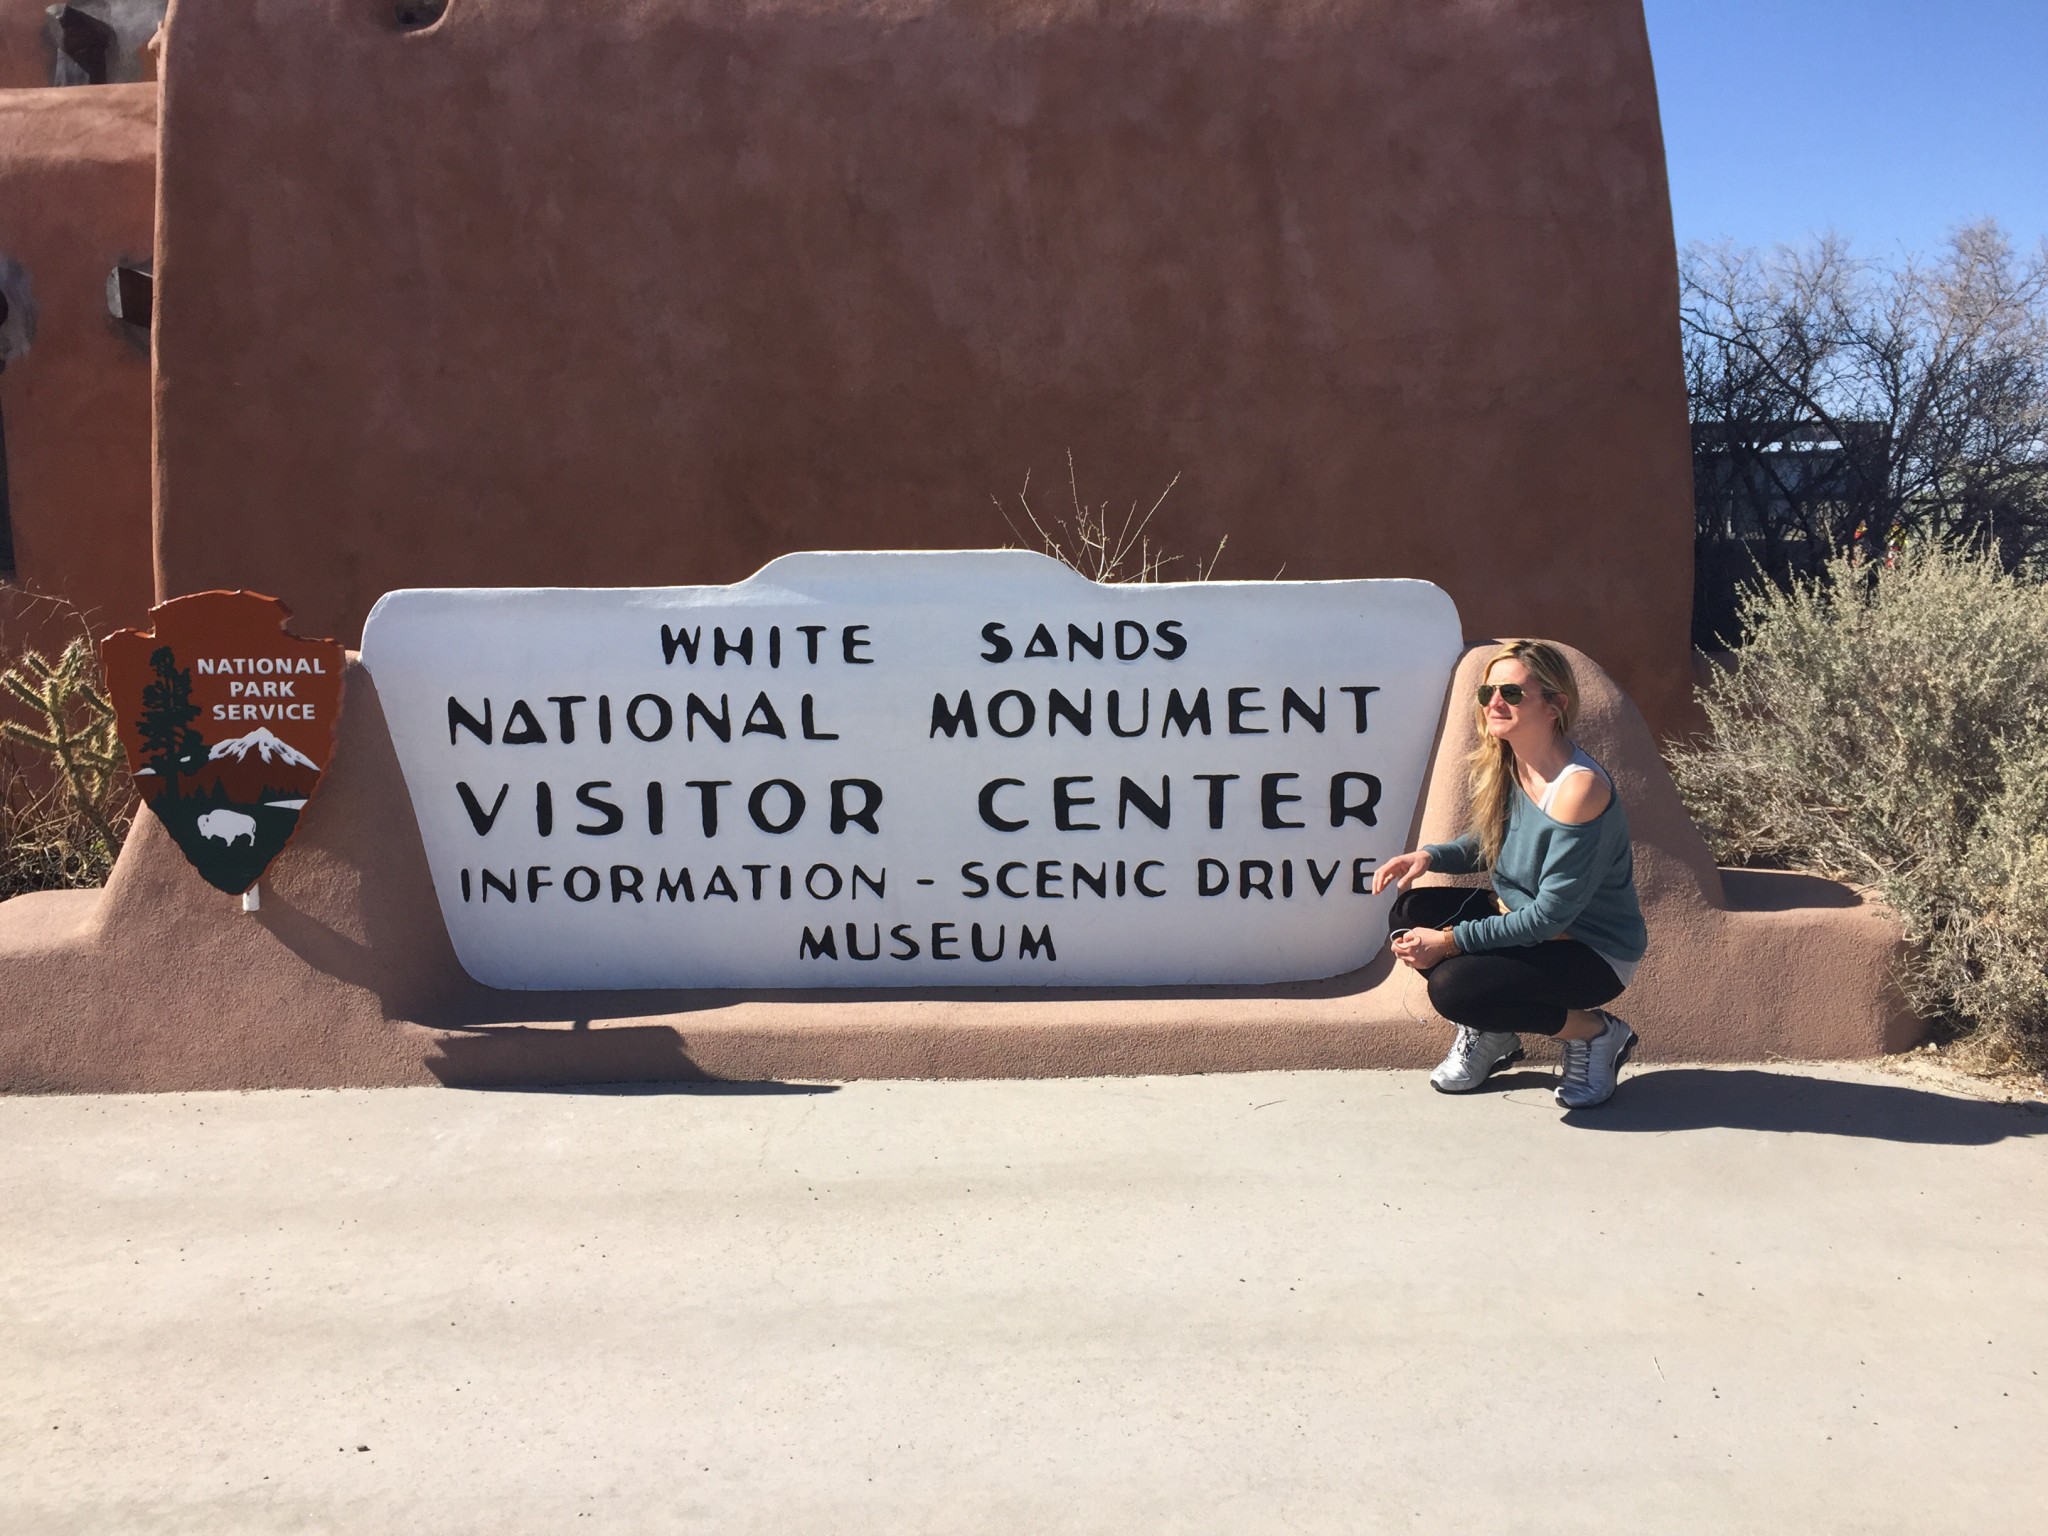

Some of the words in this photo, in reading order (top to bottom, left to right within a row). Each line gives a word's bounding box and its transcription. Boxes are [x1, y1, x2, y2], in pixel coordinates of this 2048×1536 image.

[661, 625, 874, 668] WHITE
[980, 621, 1188, 663] SANDS
[197, 658, 326, 675] NATIONAL
[230, 681, 295, 698] PARK
[212, 703, 316, 721] SERVICE
[447, 691, 840, 746] NATIONAL
[929, 687, 1381, 739] MONUMENT
[456, 778, 883, 838] VISITOR
[978, 771, 1382, 832] CENTER
[460, 863, 886, 903] INFORMATION
[961, 860, 1167, 899] SCENIC
[1197, 857, 1377, 900] DRIVE
[799, 922, 1057, 962] MUSEUM
